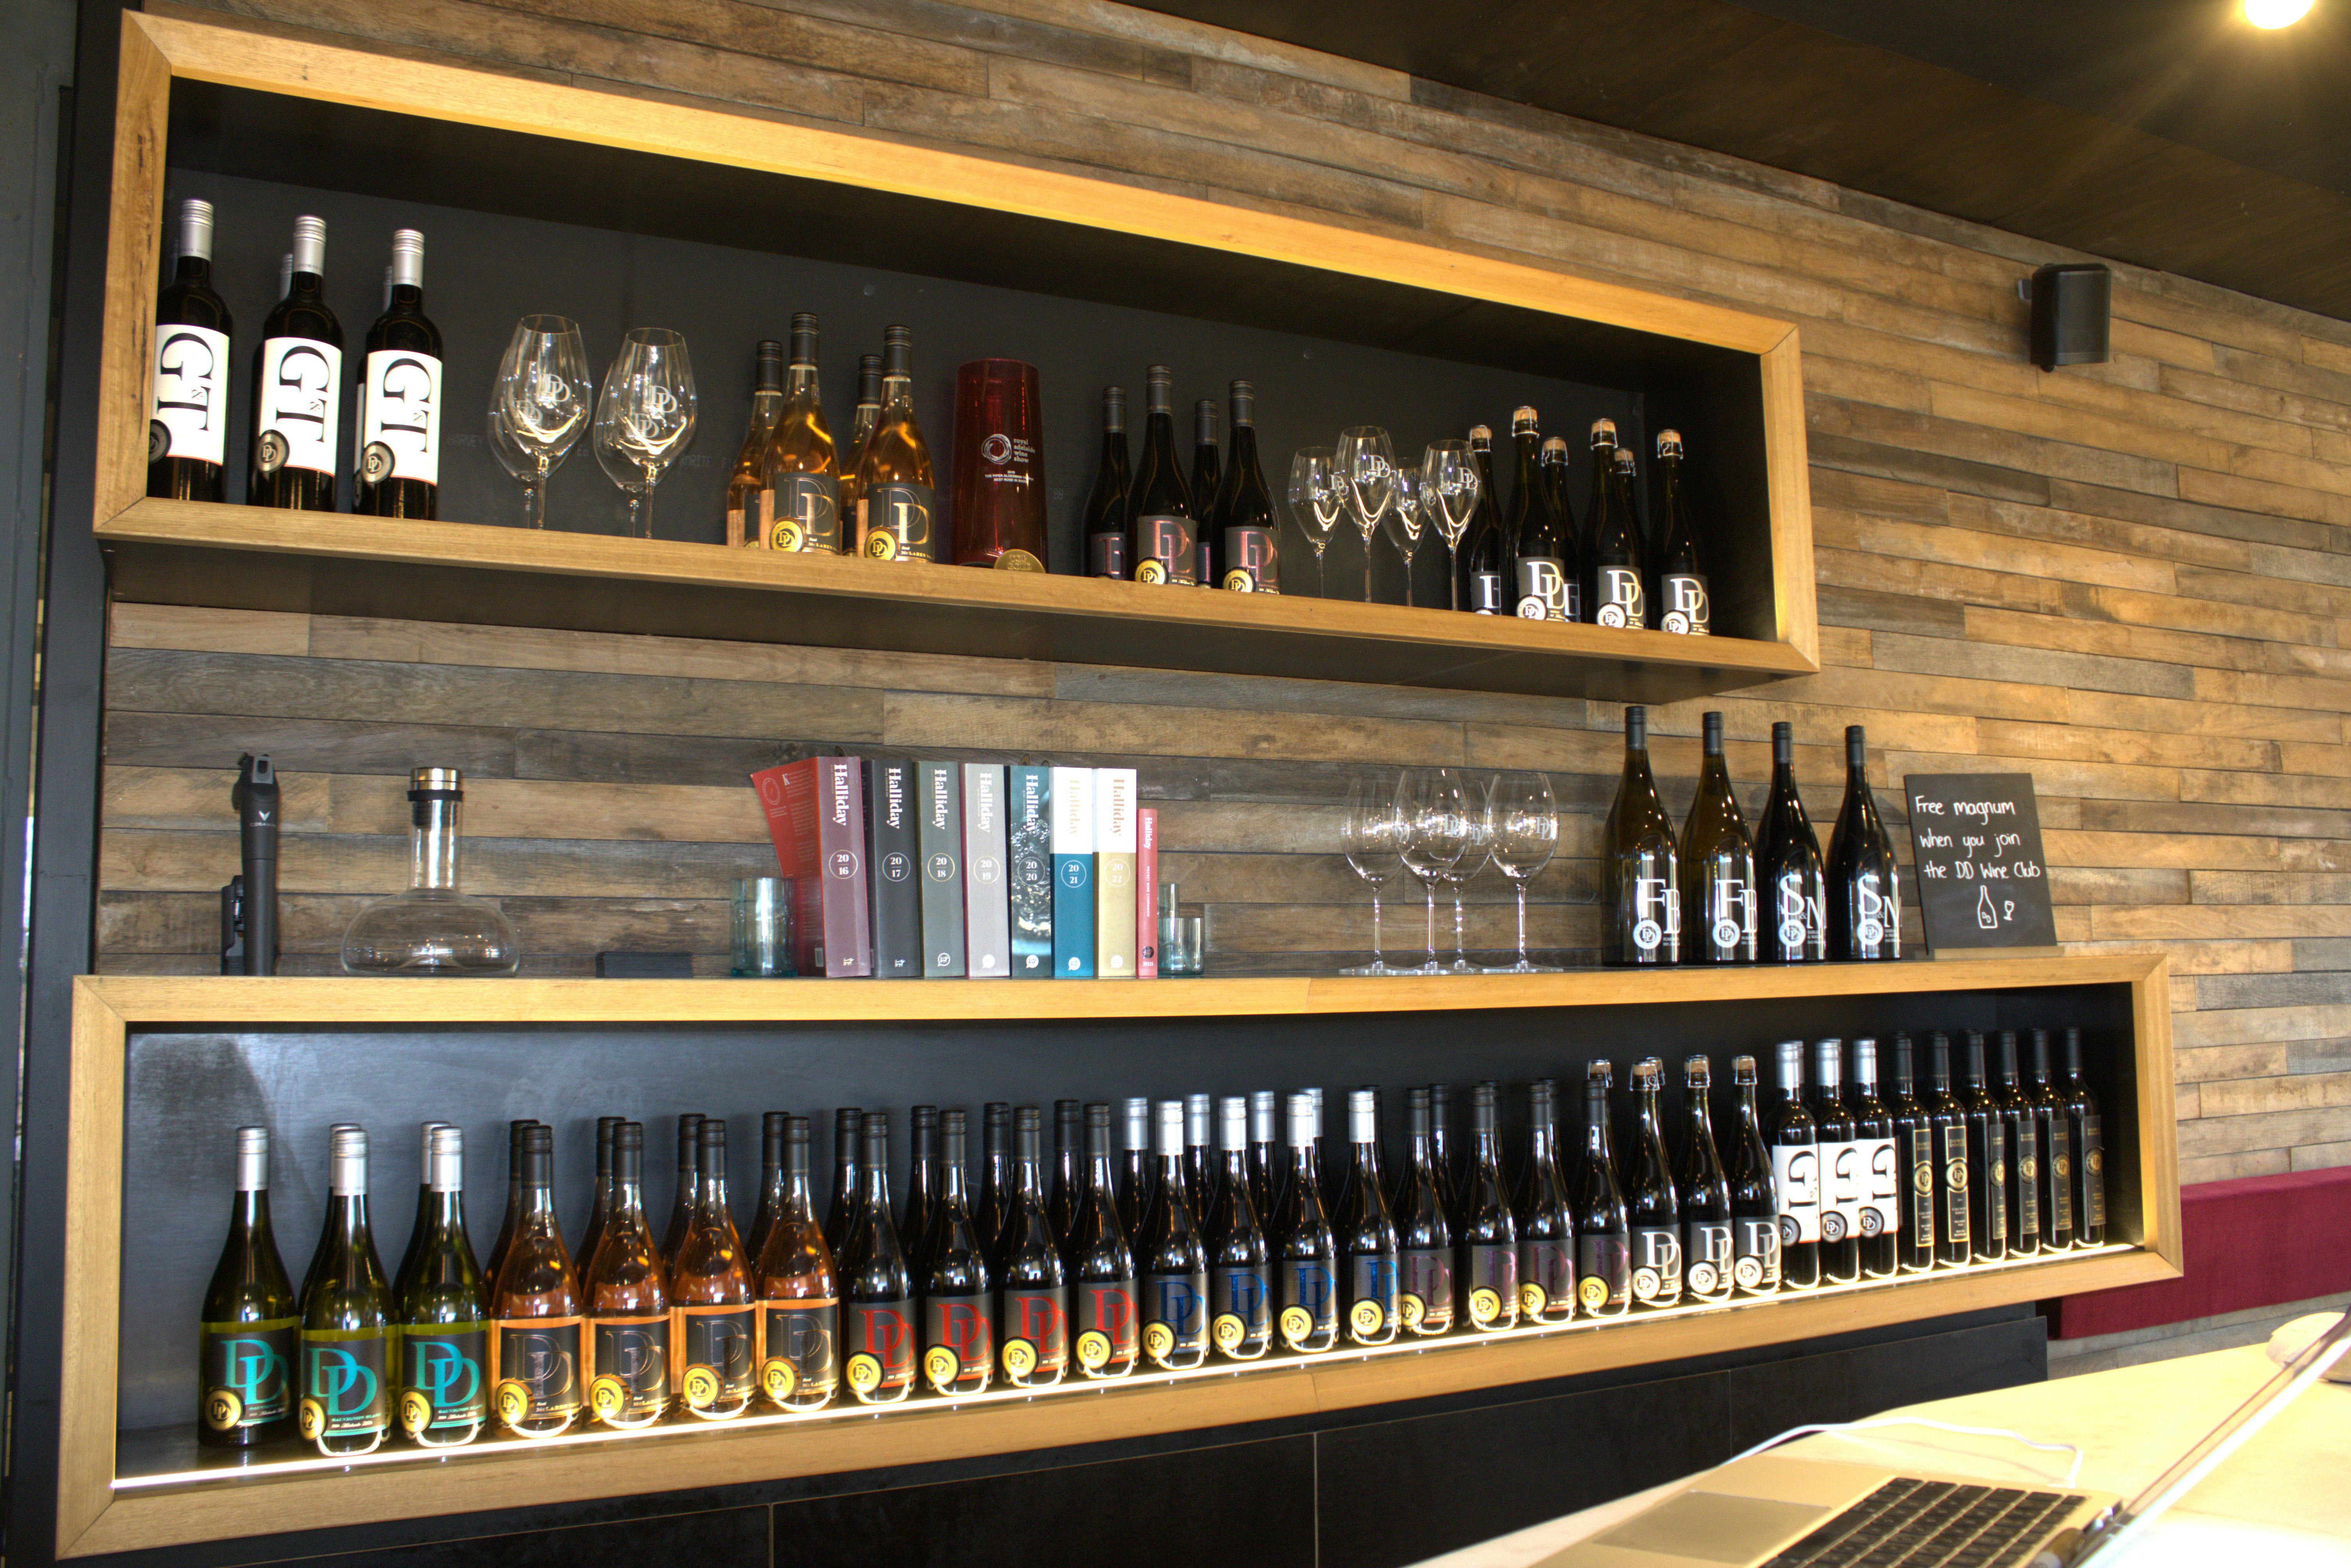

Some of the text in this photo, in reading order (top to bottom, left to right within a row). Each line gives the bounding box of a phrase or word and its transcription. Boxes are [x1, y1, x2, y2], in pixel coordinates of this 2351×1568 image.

[157, 332, 214, 431] G&T
[276, 345, 330, 442] G&T
[381, 358, 431, 453] G&T
[1014, 444, 1035, 453] adelaide
[832, 764, 849, 826] Halliday
[887, 768, 902, 829] Halliday
[932, 769, 948, 829] Halliday
[978, 773, 993, 832] Halliday
[1023, 774, 1038, 834] Halliday
[1067, 779, 1080, 837] Halliday
[1110, 778, 1124, 837] Halliday
[1915, 795, 2016, 825] Free magnum
[1143, 817, 1152, 849] Halliday
[1919, 828, 2021, 858] when you join
[981, 860, 992, 868] 20
[1026, 861, 1037, 869] 20
[1112, 875, 1122, 883] 22
[1923, 860, 2041, 879] the DD Wine Club
